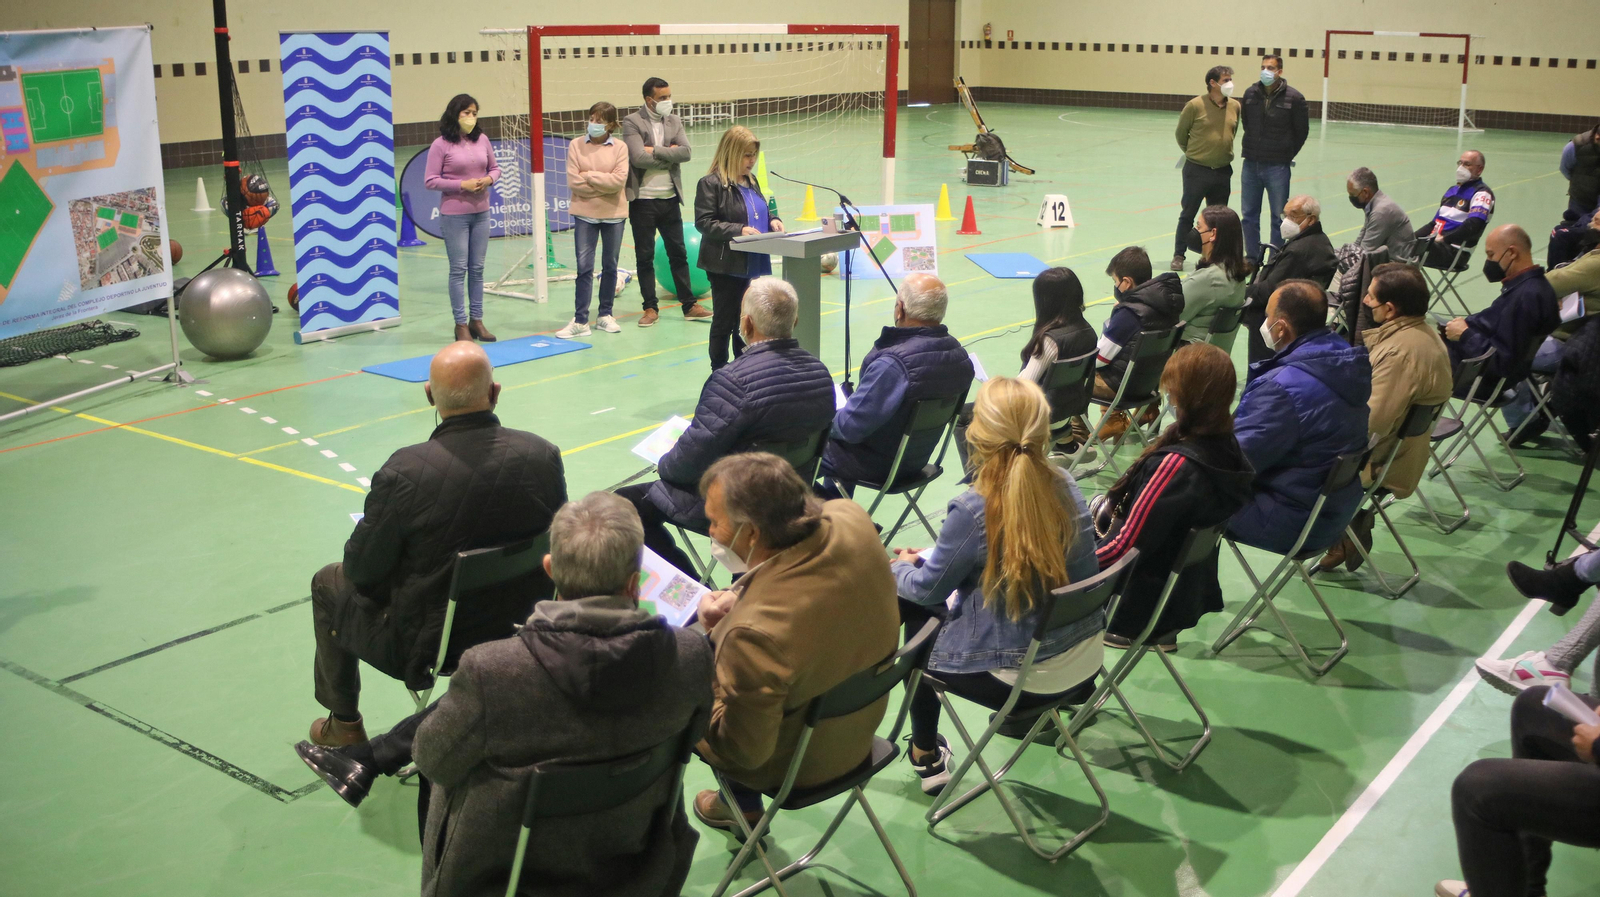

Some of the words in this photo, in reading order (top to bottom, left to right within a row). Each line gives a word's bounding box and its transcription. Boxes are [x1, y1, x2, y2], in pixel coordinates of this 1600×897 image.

[235, 211, 245, 251] TARMAK
[1052, 202, 1065, 221] 12
[11, 312, 40, 323] REFORMA
[40, 306, 66, 317] INTEGRAL
[77, 296, 106, 308] COMPLEJO
[106, 289, 135, 301] DEPORTIVO
[142, 281, 168, 292] JUVENTUD
